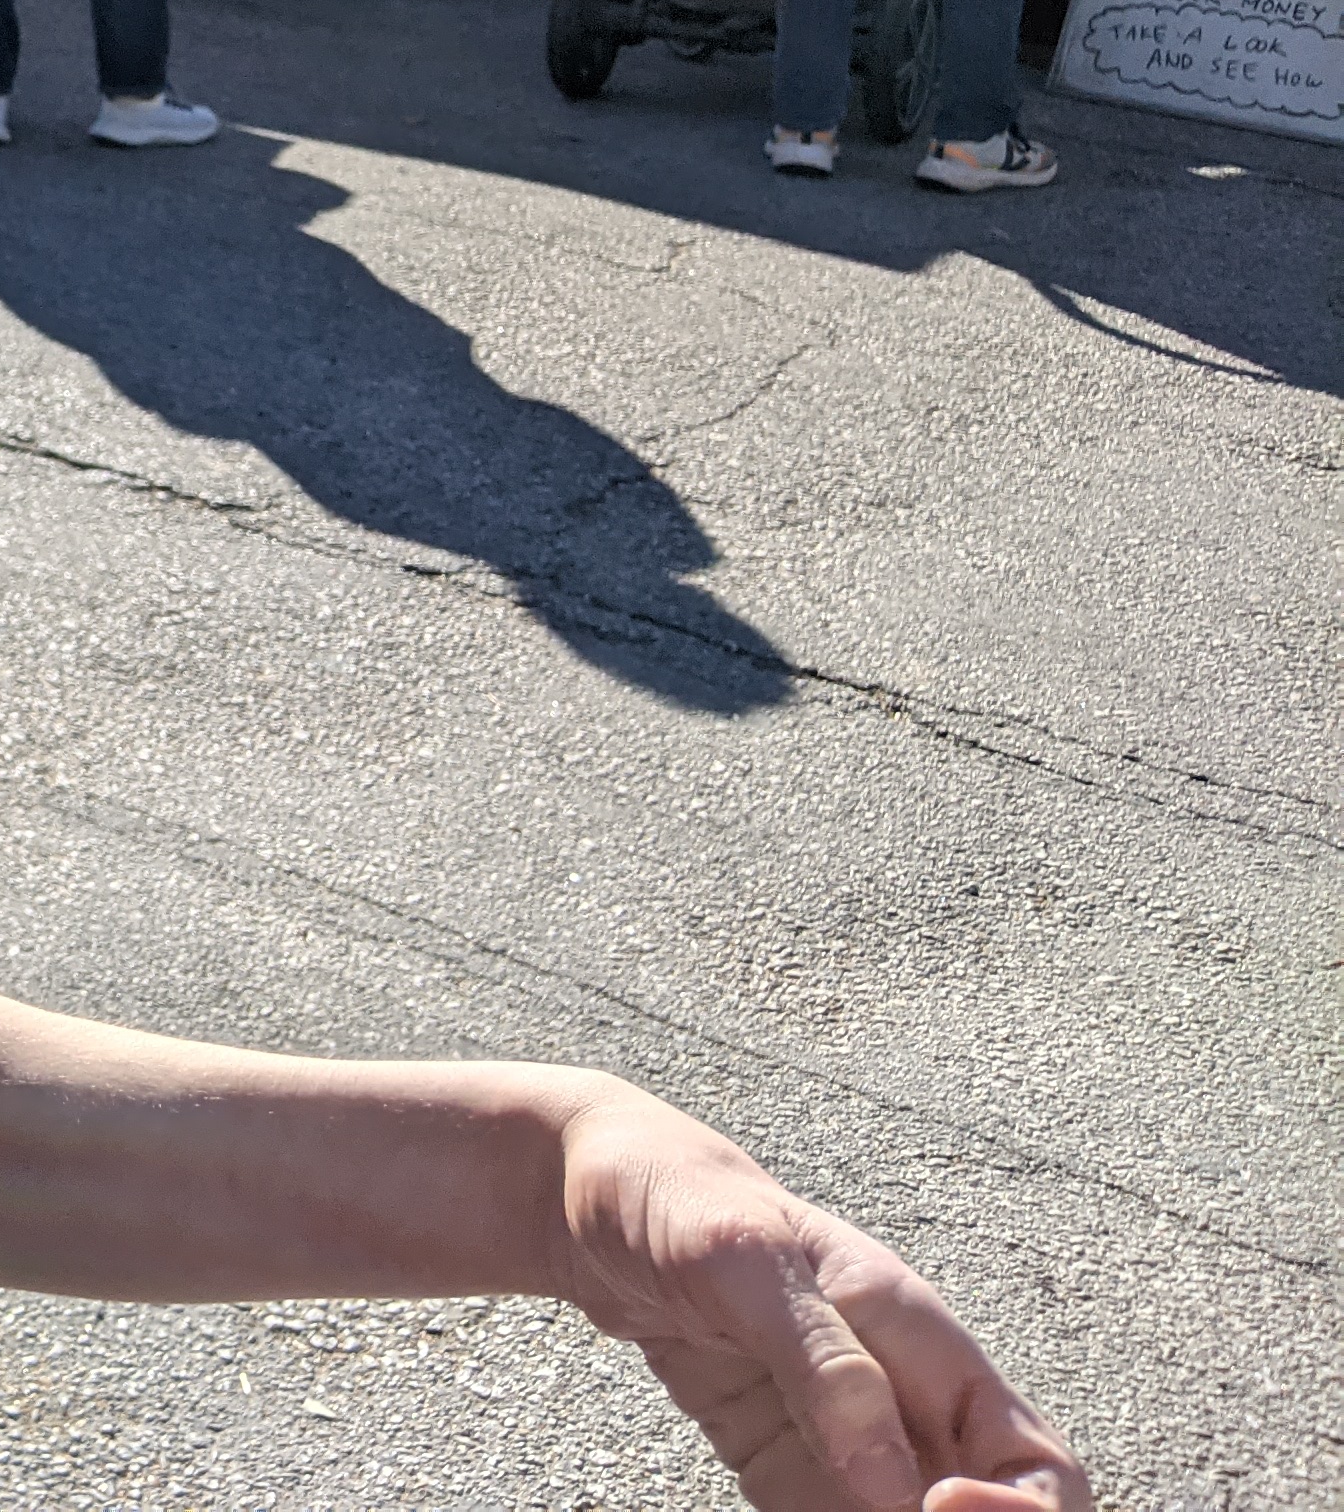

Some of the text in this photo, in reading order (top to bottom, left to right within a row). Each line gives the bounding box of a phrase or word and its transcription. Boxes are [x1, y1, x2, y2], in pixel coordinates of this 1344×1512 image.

[1110, 23, 1287, 58] TAKE A LOOK
[1145, 47, 1324, 90] AND SEE HOW
